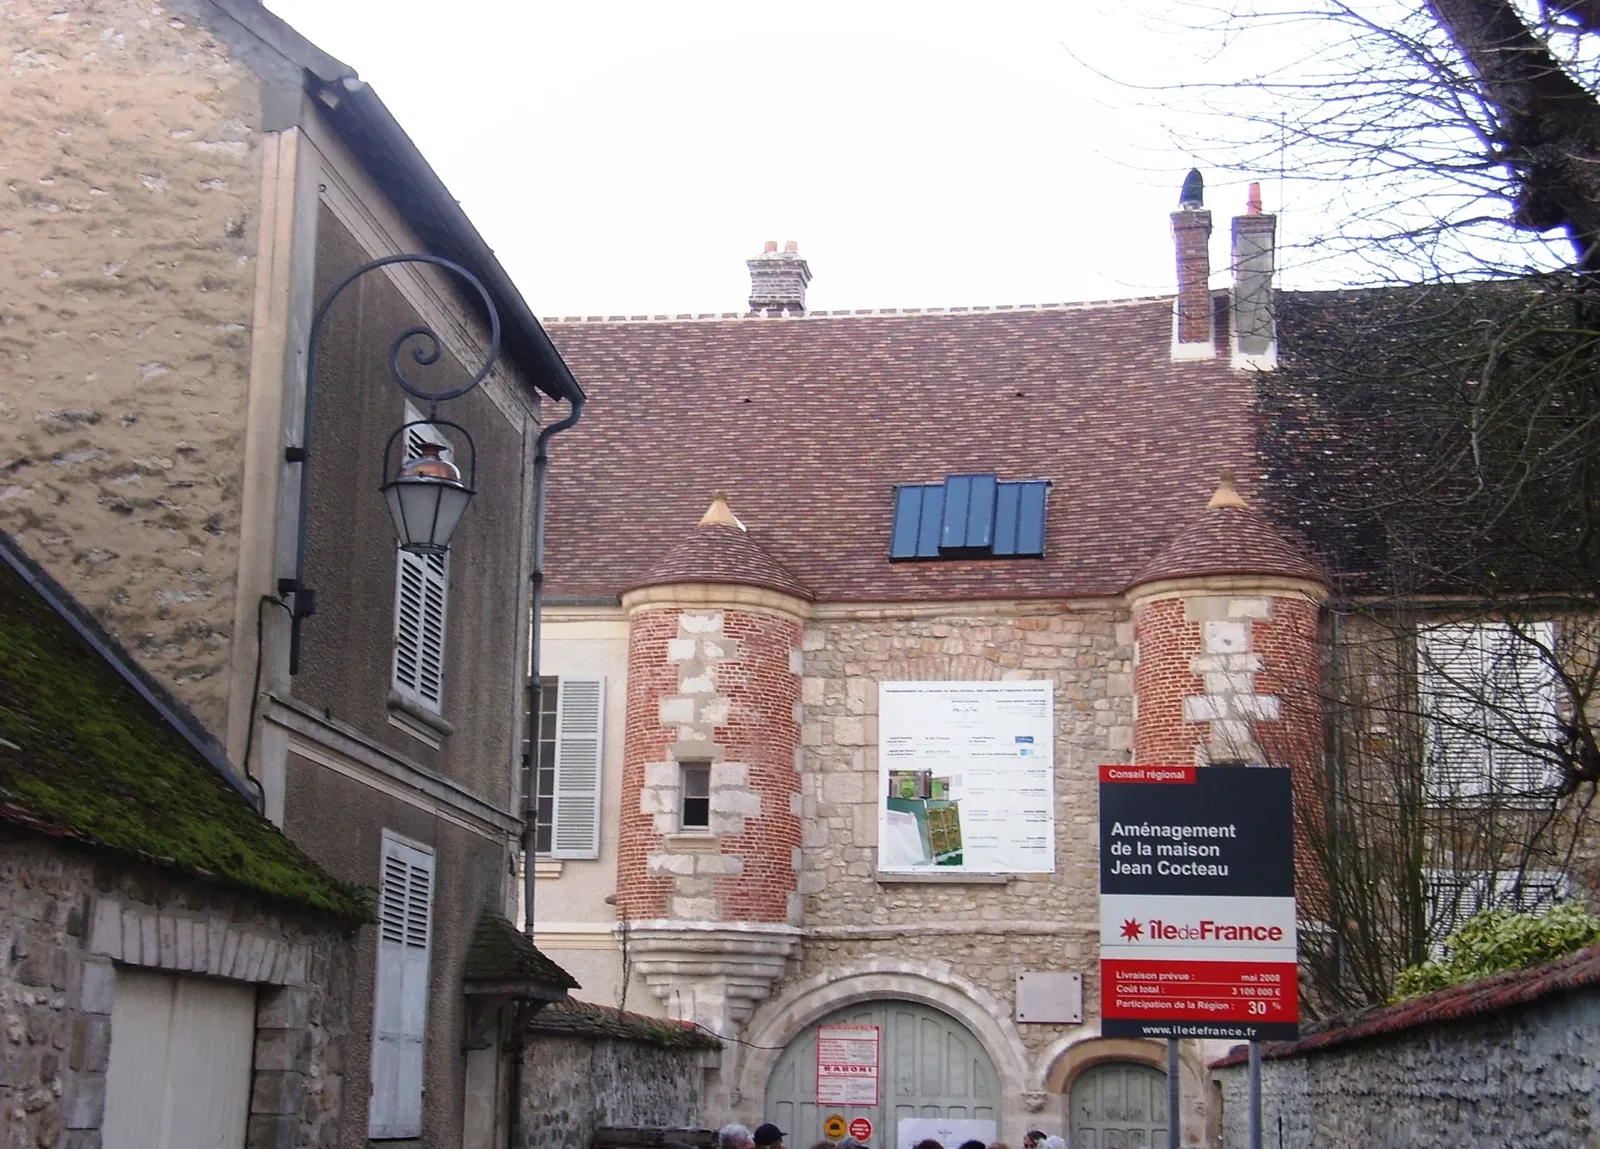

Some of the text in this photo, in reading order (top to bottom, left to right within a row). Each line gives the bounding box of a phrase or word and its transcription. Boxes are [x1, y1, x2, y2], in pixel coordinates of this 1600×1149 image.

[1108, 769, 1185, 781] Conseil régional
[1111, 822, 1236, 840] Aménagement
[1110, 841, 1221, 857] de la maison
[1110, 859, 1230, 876] Jean Cocteau
[1115, 970, 1158, 980] Livraison
[1158, 972, 1190, 982] prévue
[1240, 974, 1259, 982] mai
[1116, 984, 1139, 994] Coût
[1139, 985, 1160, 994] total
[1231, 987, 1238, 996] 3
[1239, 987, 1256, 997] 100
[1256, 987, 1274, 997] 000
[1116, 999, 1172, 1010] Participation
[1173, 1001, 1186, 1010] de
[1186, 1001, 1196, 1010] la
[1197, 1001, 1230, 1012] Région
[1248, 1001, 1267, 1015] 30
[1142, 1024, 1257, 1037] www.iledefrance.fr
